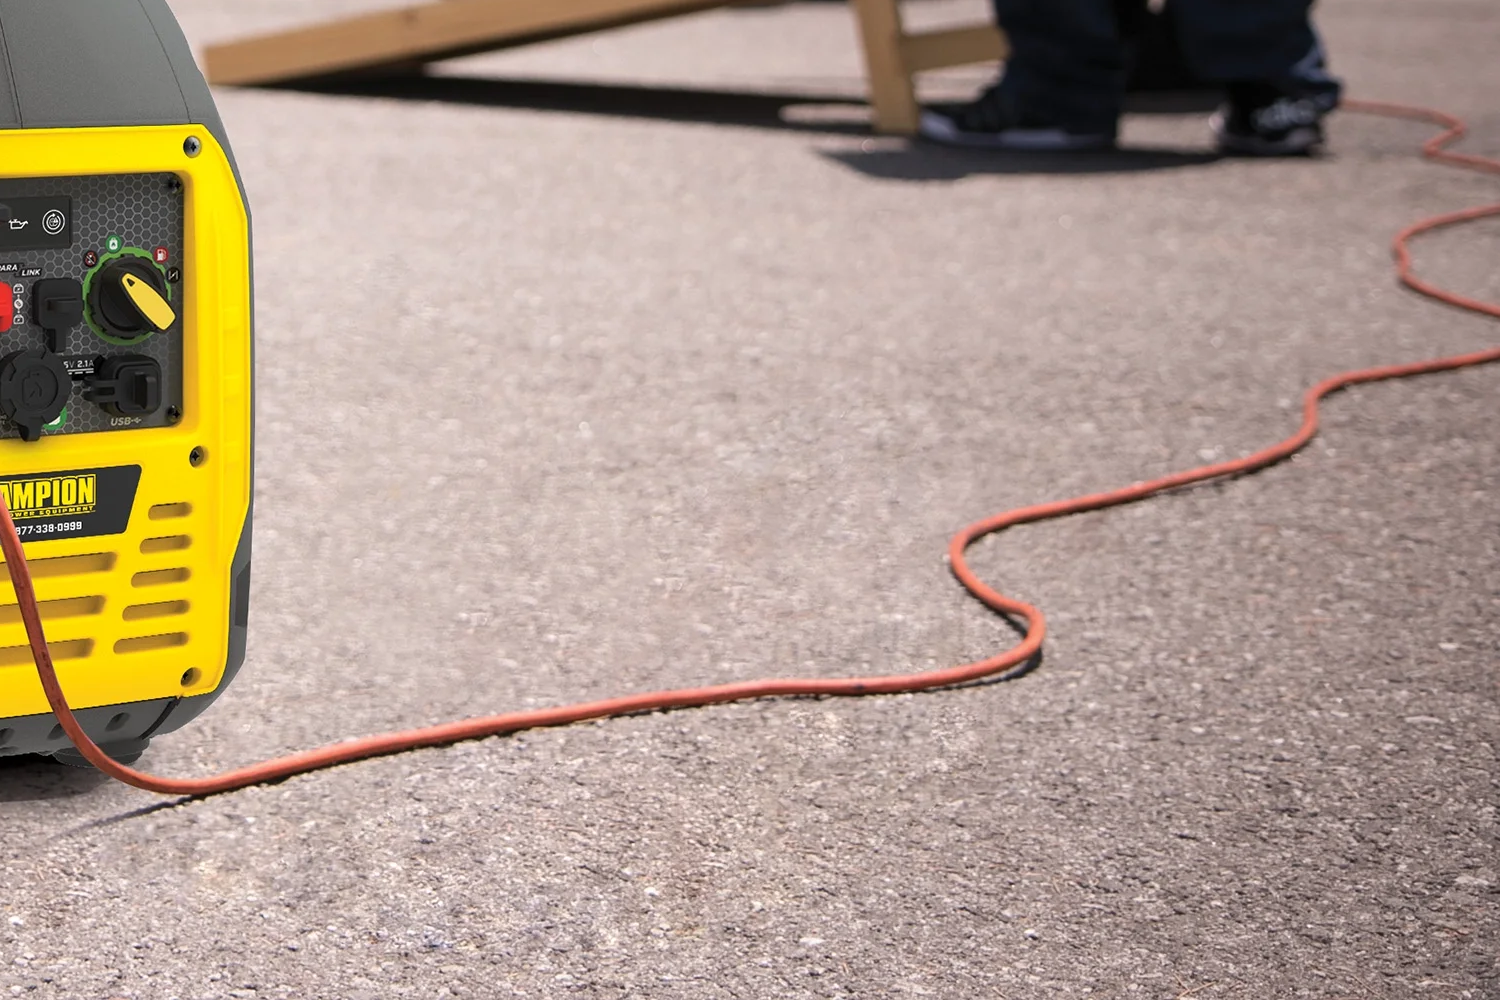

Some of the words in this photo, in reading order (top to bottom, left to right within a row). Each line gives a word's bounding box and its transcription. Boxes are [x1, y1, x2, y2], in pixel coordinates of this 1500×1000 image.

[21, 268, 41, 277] LINK
[77, 359, 95, 368] 2.1A
[110, 417, 130, 426] USB
[39, 505, 94, 516] EQUIPMENT
